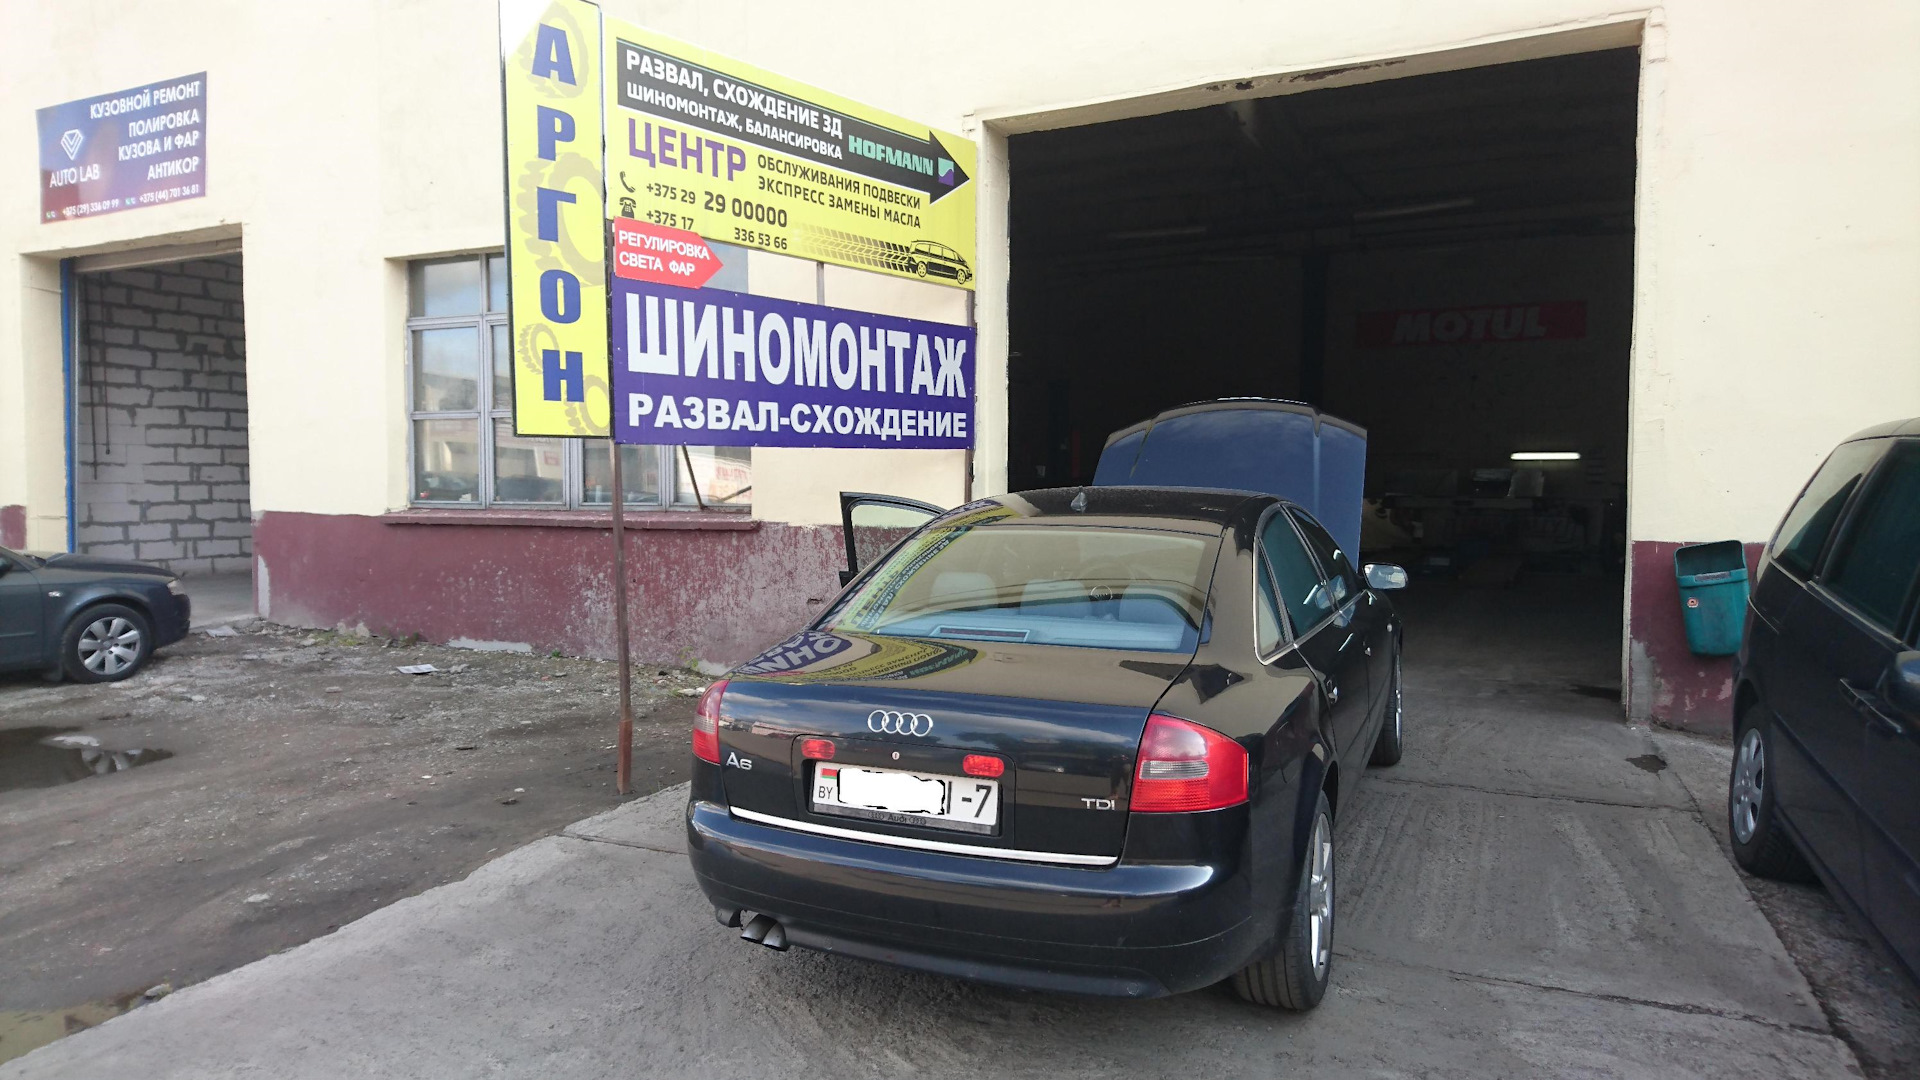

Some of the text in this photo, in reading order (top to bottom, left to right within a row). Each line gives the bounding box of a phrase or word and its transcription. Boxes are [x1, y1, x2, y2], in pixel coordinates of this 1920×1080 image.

[90, 81, 200, 119] КУЗОВНОЙ РЕМОНТ
[626, 49, 709, 97] РАЗВАЛ,
[713, 79, 819, 129] СХОЖДЕНИЕ
[129, 109, 199, 137] ПОЛИРОВКА
[627, 82, 843, 160] ШИНОМОНТАЖ, БАЛАНСИРОВКА
[118, 131, 199, 161] КУЗОВА И ФАР
[628, 117, 747, 182] ЦЕНТР
[849, 135, 934, 176] HOFMANN
[49, 163, 100, 188] AUTO LAB
[147, 156, 199, 180] АНТИКОР
[757, 154, 920, 210] ОБСЛУЖИВАНИЯ ПОДВЕСКИ
[531, 23, 585, 403] АРГОН
[646, 183, 787, 228] +375 29 29 00000
[757, 175, 921, 228] ЭКСПРЕСС ЗАМЕНЫ МАСЛА
[618, 230, 711, 260] РЕГУЛИРОВКА
[646, 210, 788, 250] +375 17 336 53 66
[619, 251, 696, 276] СВЕТА ФАР
[1391, 305, 1548, 344] MOTUL
[626, 292, 967, 398] ШИНОМОНТАЖ
[628, 392, 967, 441] РАЗВАЛ-СХОЖДЕНИЕ
[726, 751, 753, 770] A6
[818, 785, 833, 800] BY
[1081, 798, 1116, 811] TDI
